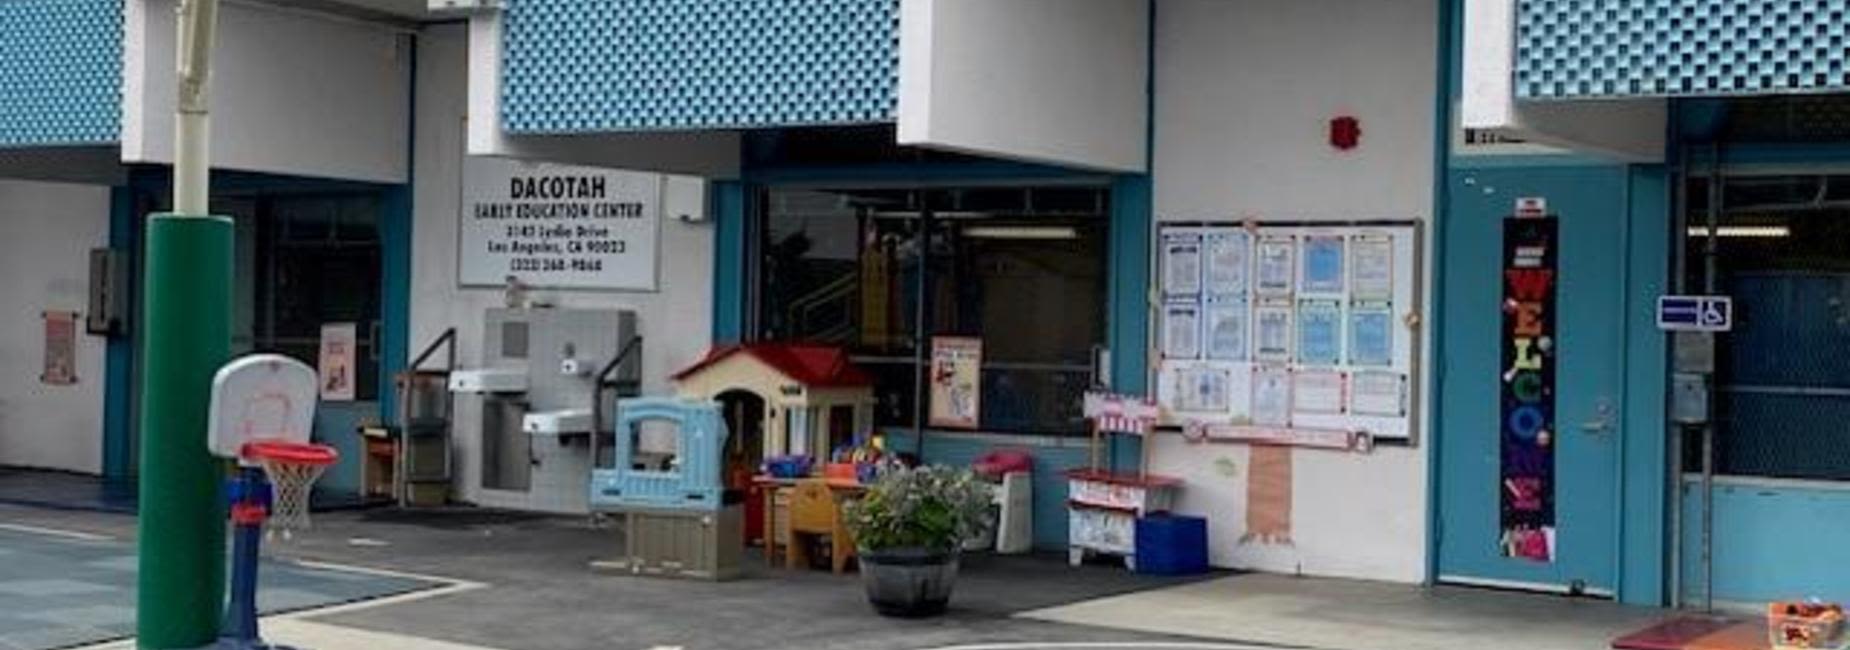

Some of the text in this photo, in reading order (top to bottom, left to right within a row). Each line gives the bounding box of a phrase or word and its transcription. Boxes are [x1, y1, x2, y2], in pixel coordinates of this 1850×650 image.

[510, 176, 606, 199] DACOTAH
[475, 203, 643, 219] EARLY EDUCATION CENTER
[577, 224, 609, 238] Drive
[487, 240, 508, 253] Los
[511, 240, 562, 256] Angeles,
[567, 240, 582, 254] CA
[1506, 269, 1550, 509] WELCOME
